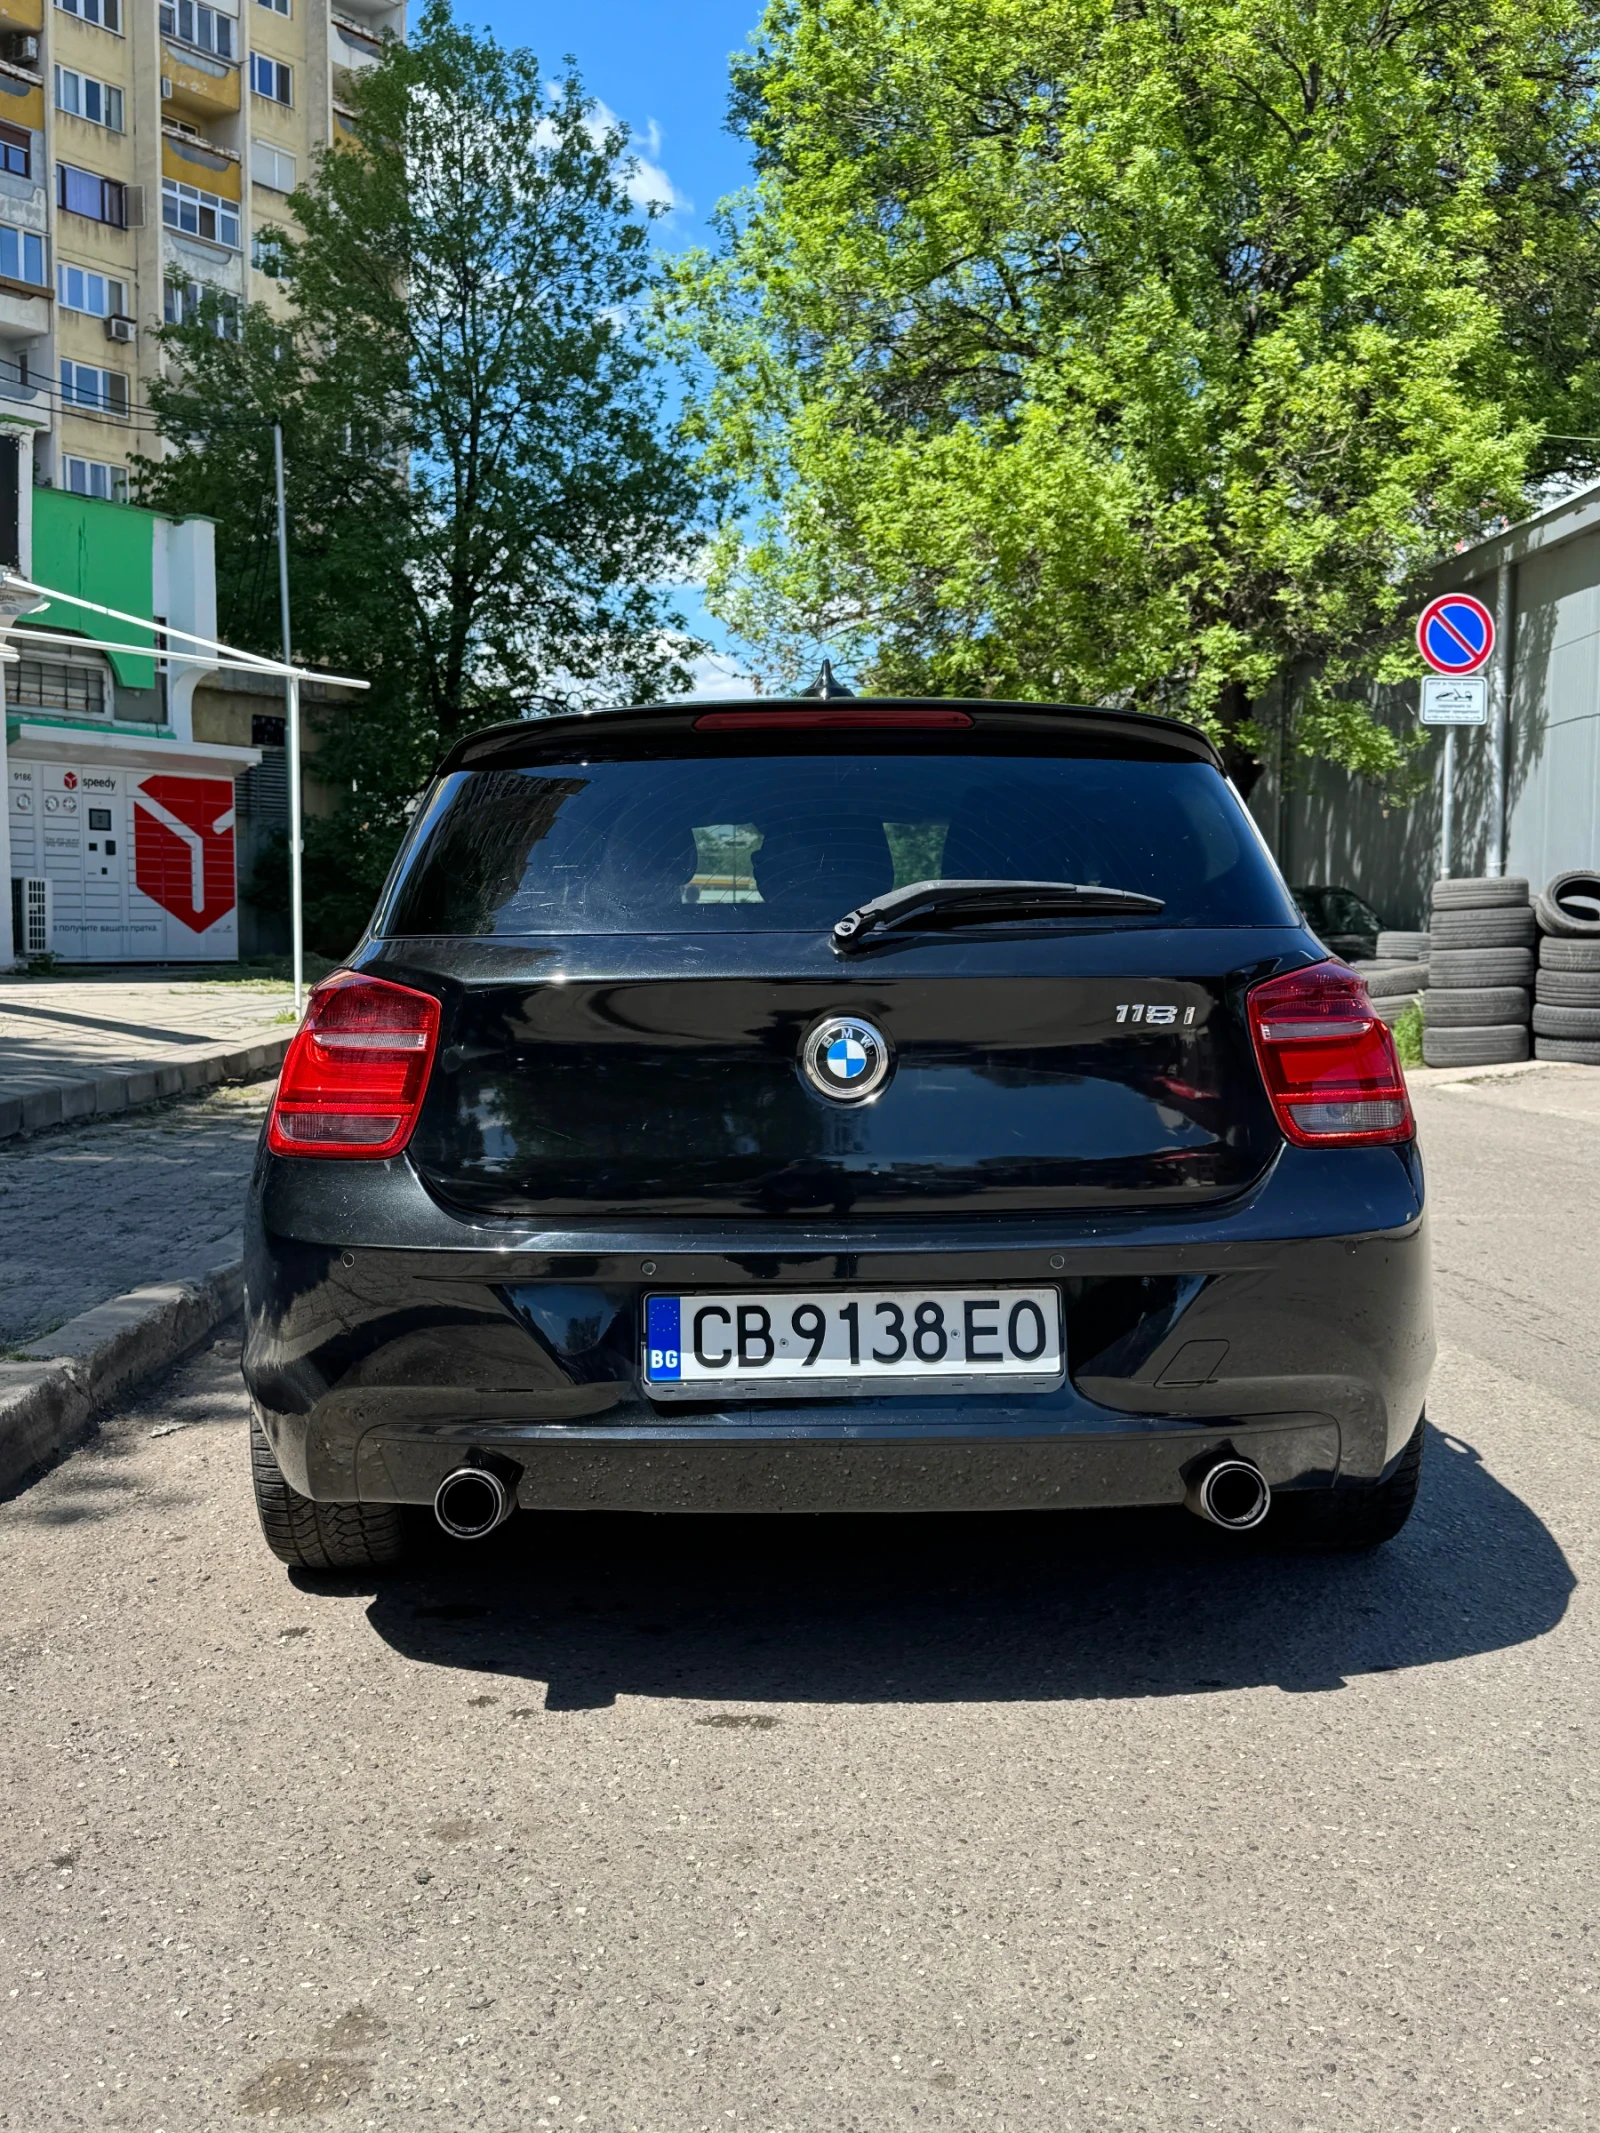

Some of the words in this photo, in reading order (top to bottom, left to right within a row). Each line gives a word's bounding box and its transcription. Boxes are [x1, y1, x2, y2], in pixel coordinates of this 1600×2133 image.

[14, 773, 32, 781] 9186
[83, 777, 116, 791] speedy
[821, 1027, 875, 1049] BMW
[791, 1301, 948, 1366] 9138
[651, 1350, 678, 1369] BG
